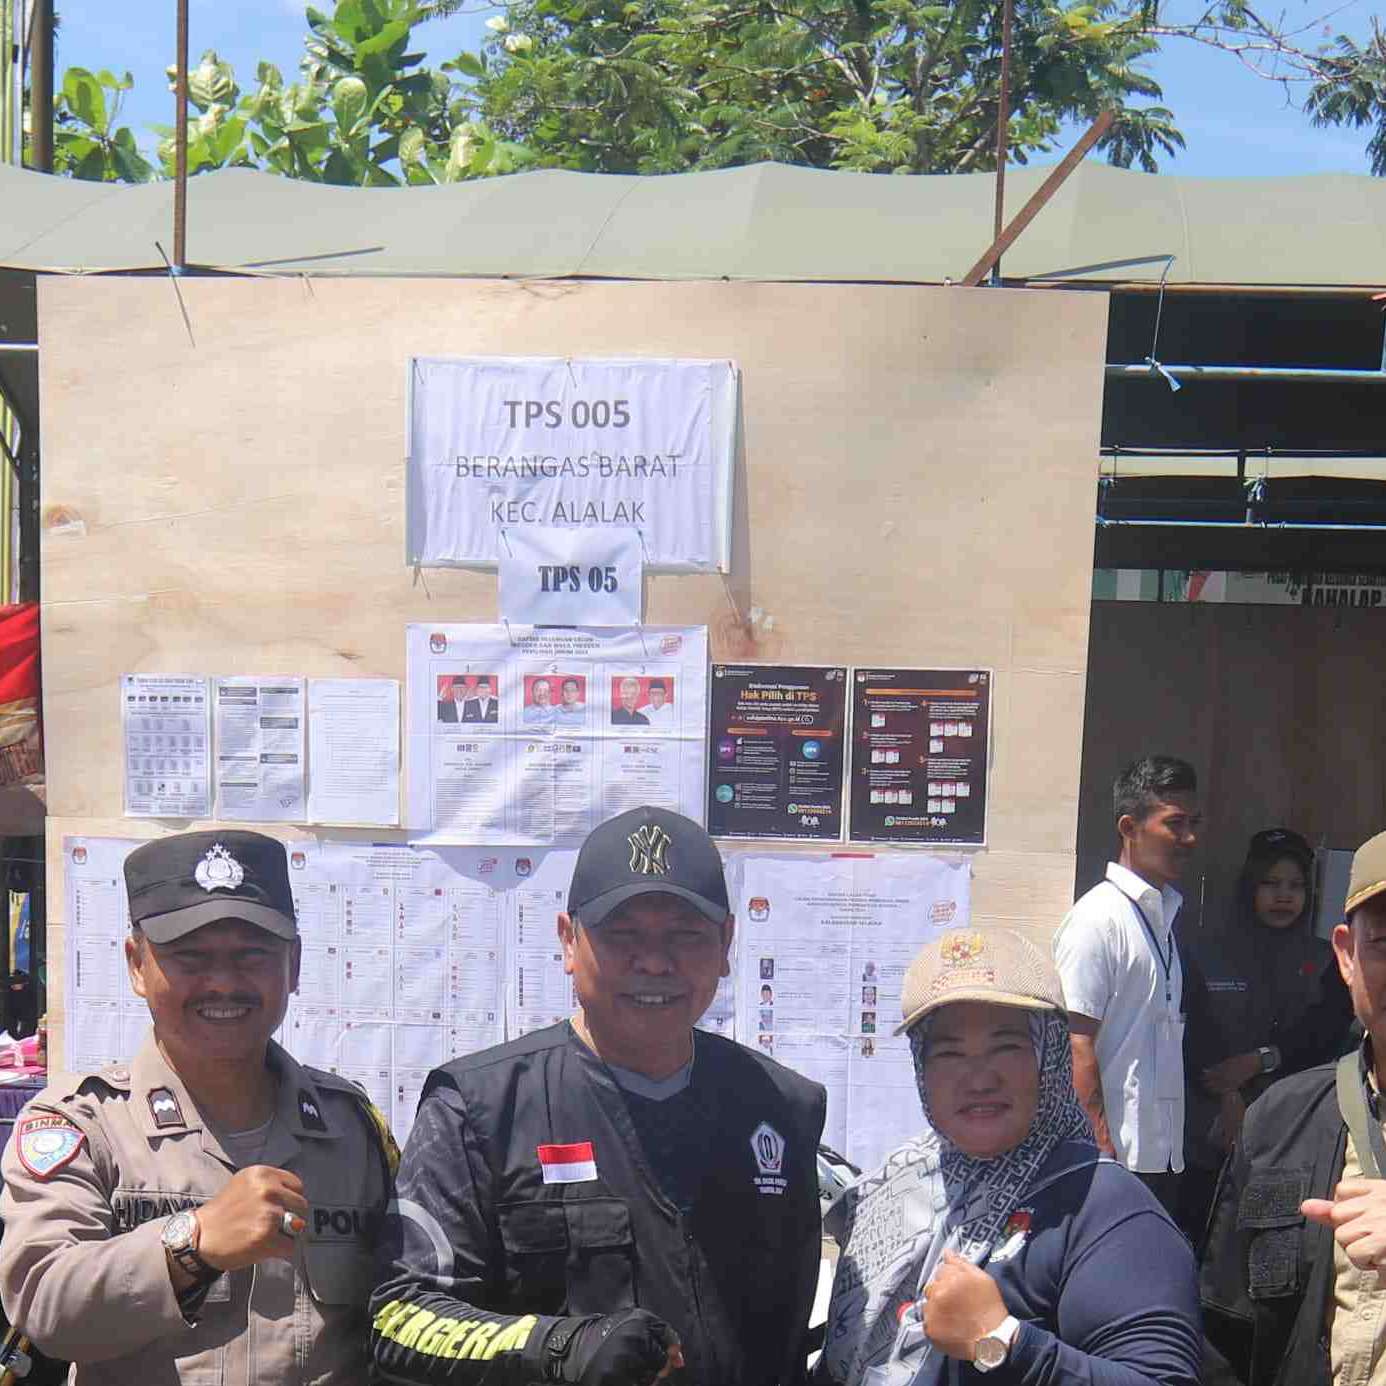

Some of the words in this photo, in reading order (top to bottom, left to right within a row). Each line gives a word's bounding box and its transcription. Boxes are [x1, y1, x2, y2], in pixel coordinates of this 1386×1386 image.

[504, 400, 563, 429] TPS
[571, 400, 631, 429] 005
[456, 455, 590, 478] BERANGAS
[599, 456, 682, 479] BARAT
[491, 501, 542, 523] KEC.
[551, 502, 646, 524] ALALAK
[538, 566, 582, 593] TPS
[588, 566, 618, 593] 05
